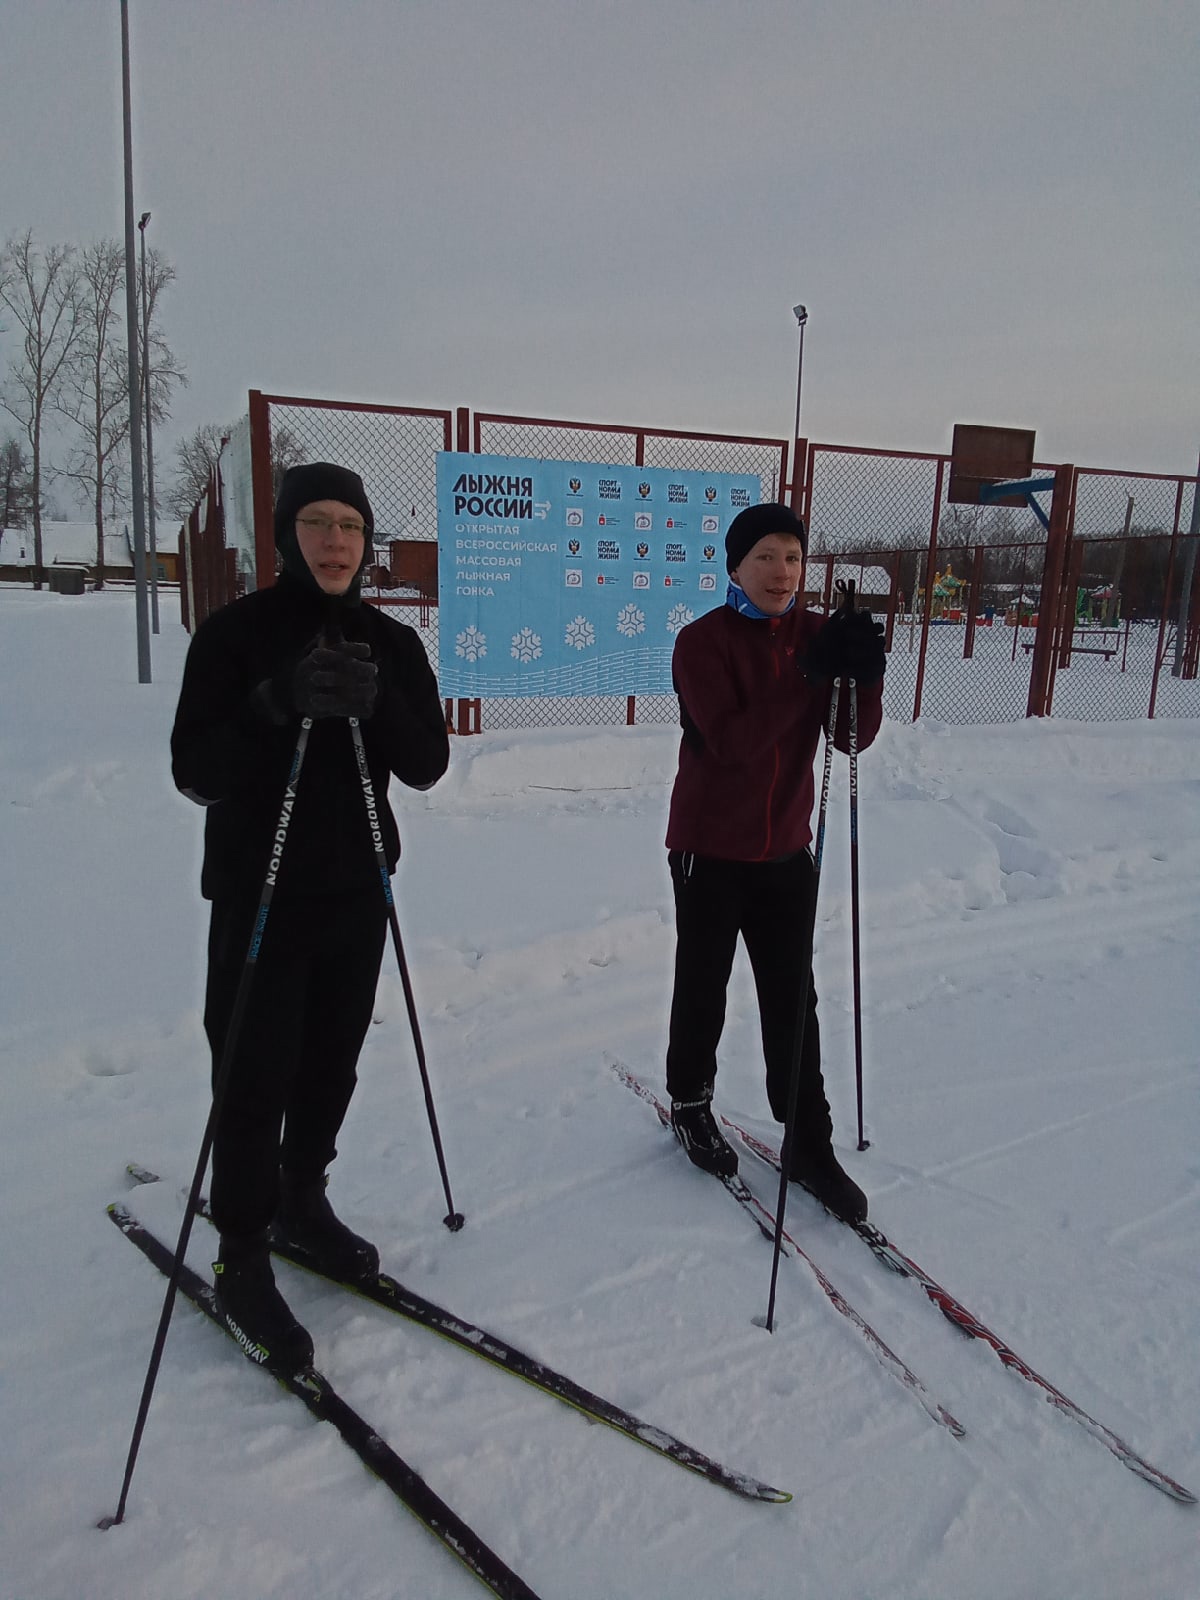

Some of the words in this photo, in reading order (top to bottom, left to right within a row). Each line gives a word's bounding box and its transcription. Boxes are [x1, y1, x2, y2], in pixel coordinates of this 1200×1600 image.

[452, 473, 533, 497] ЛЫЖНЯ
[598, 479, 618, 487] СПОРТ
[454, 495, 533, 519] РОССИИ
[455, 524, 520, 535] ОТКРЫТАЯ
[456, 539, 558, 552] ВСЕРОССИЙСКАЯ
[456, 555, 521, 567] МАССОВАЯ
[456, 571, 511, 581] ЛЫЖНАЯ
[456, 586, 494, 597] ГОНКА
[361, 776, 384, 853] NORDWAY
[265, 784, 296, 886] NORDWAY
[226, 1313, 267, 1364] NORDWAY
